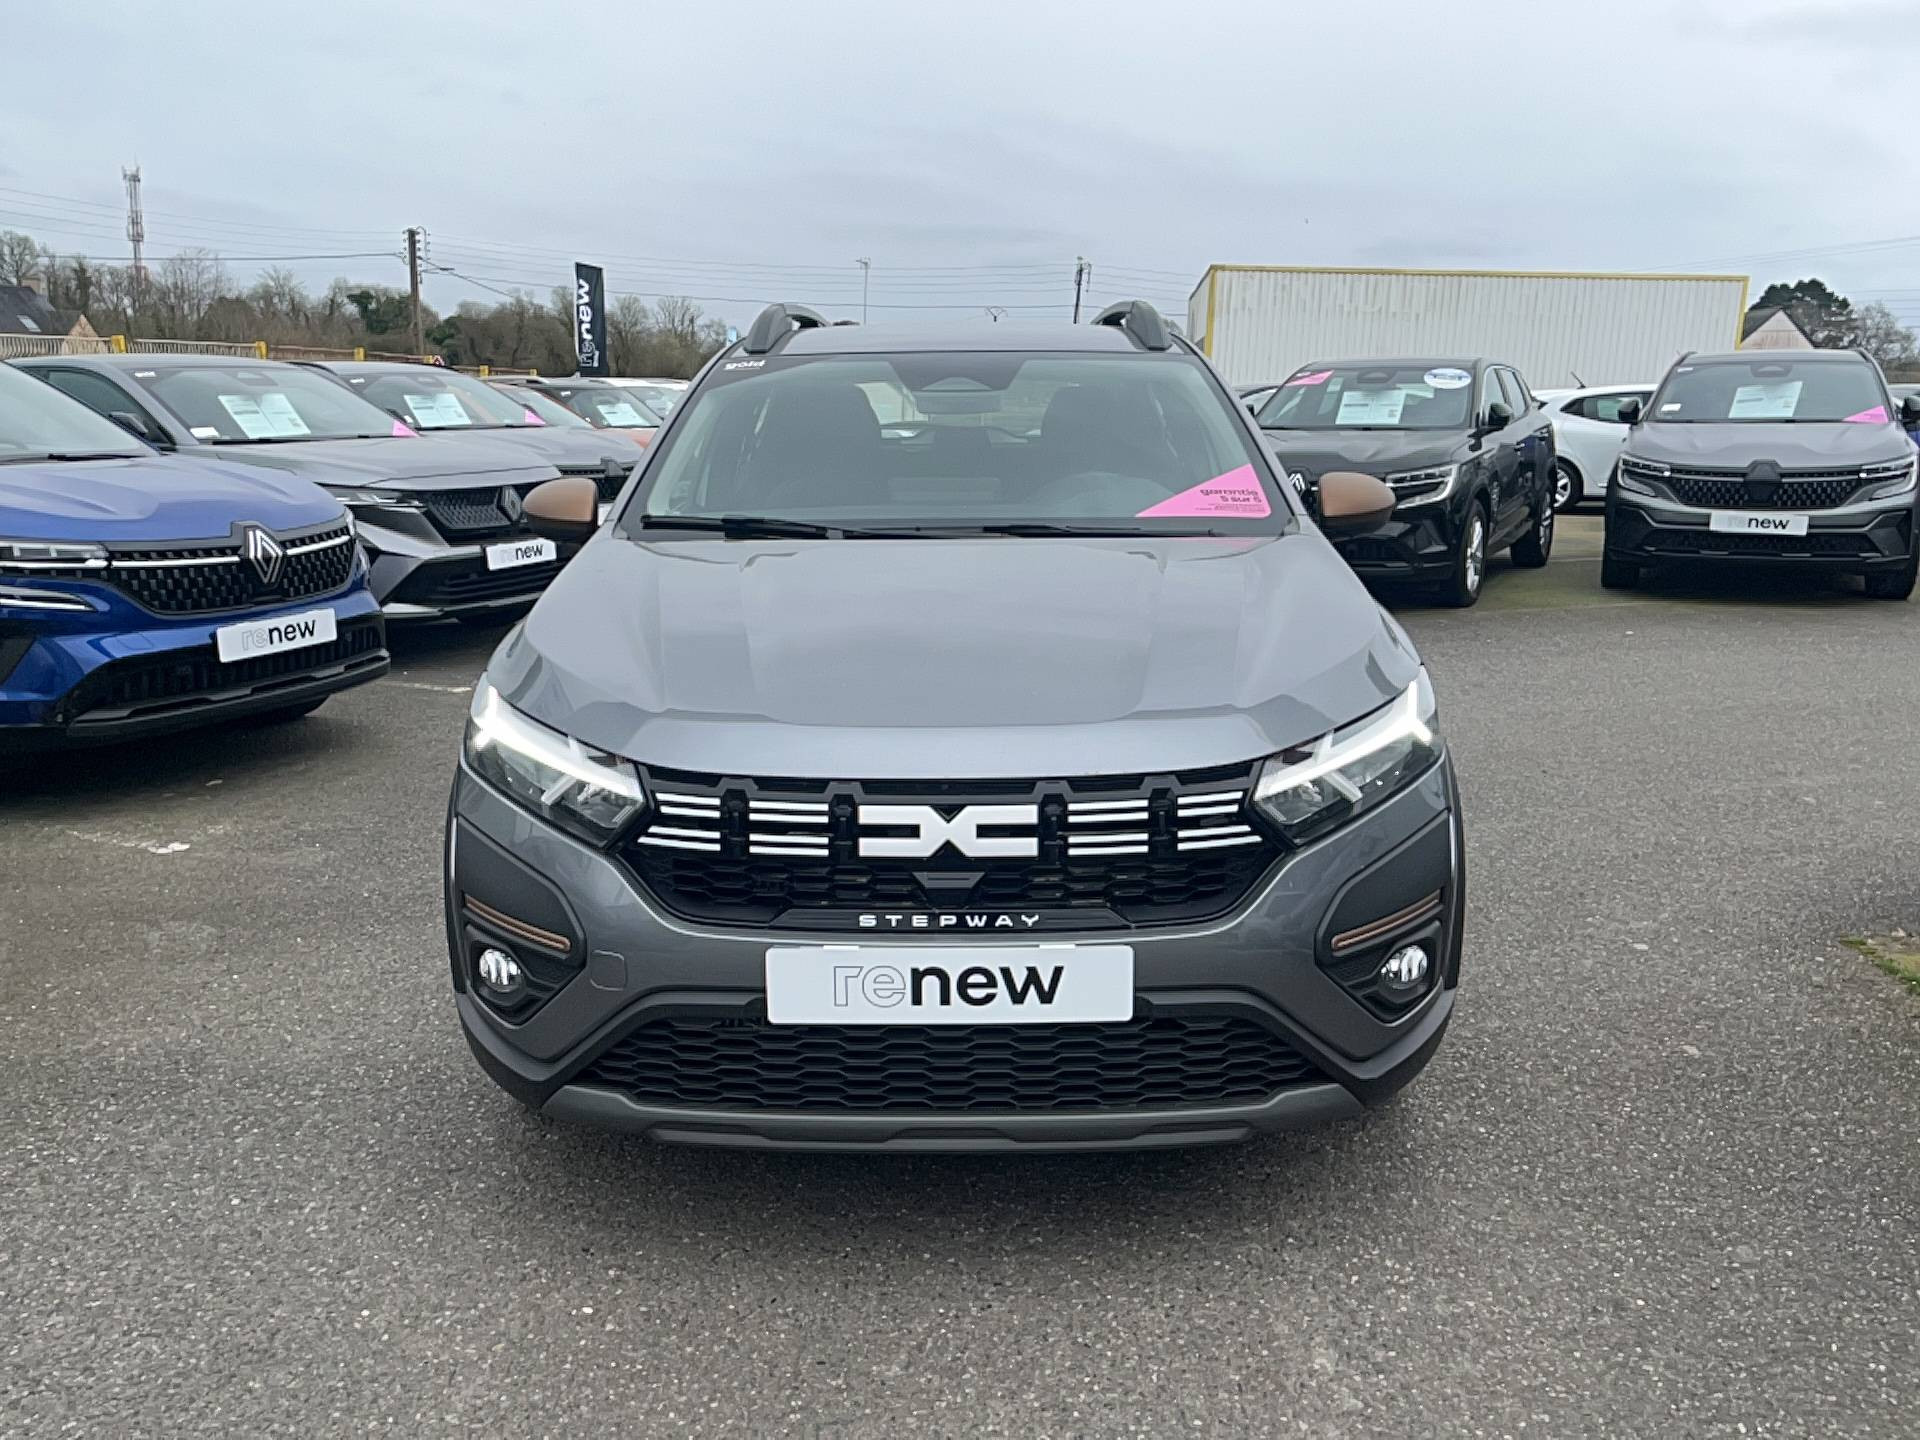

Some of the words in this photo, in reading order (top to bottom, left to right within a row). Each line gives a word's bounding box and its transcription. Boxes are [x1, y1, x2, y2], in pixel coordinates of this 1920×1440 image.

[577, 279, 595, 367] renew
[241, 619, 316, 651] renew
[858, 914, 1040, 928] STEPWAY
[833, 965, 1065, 1008] renew
